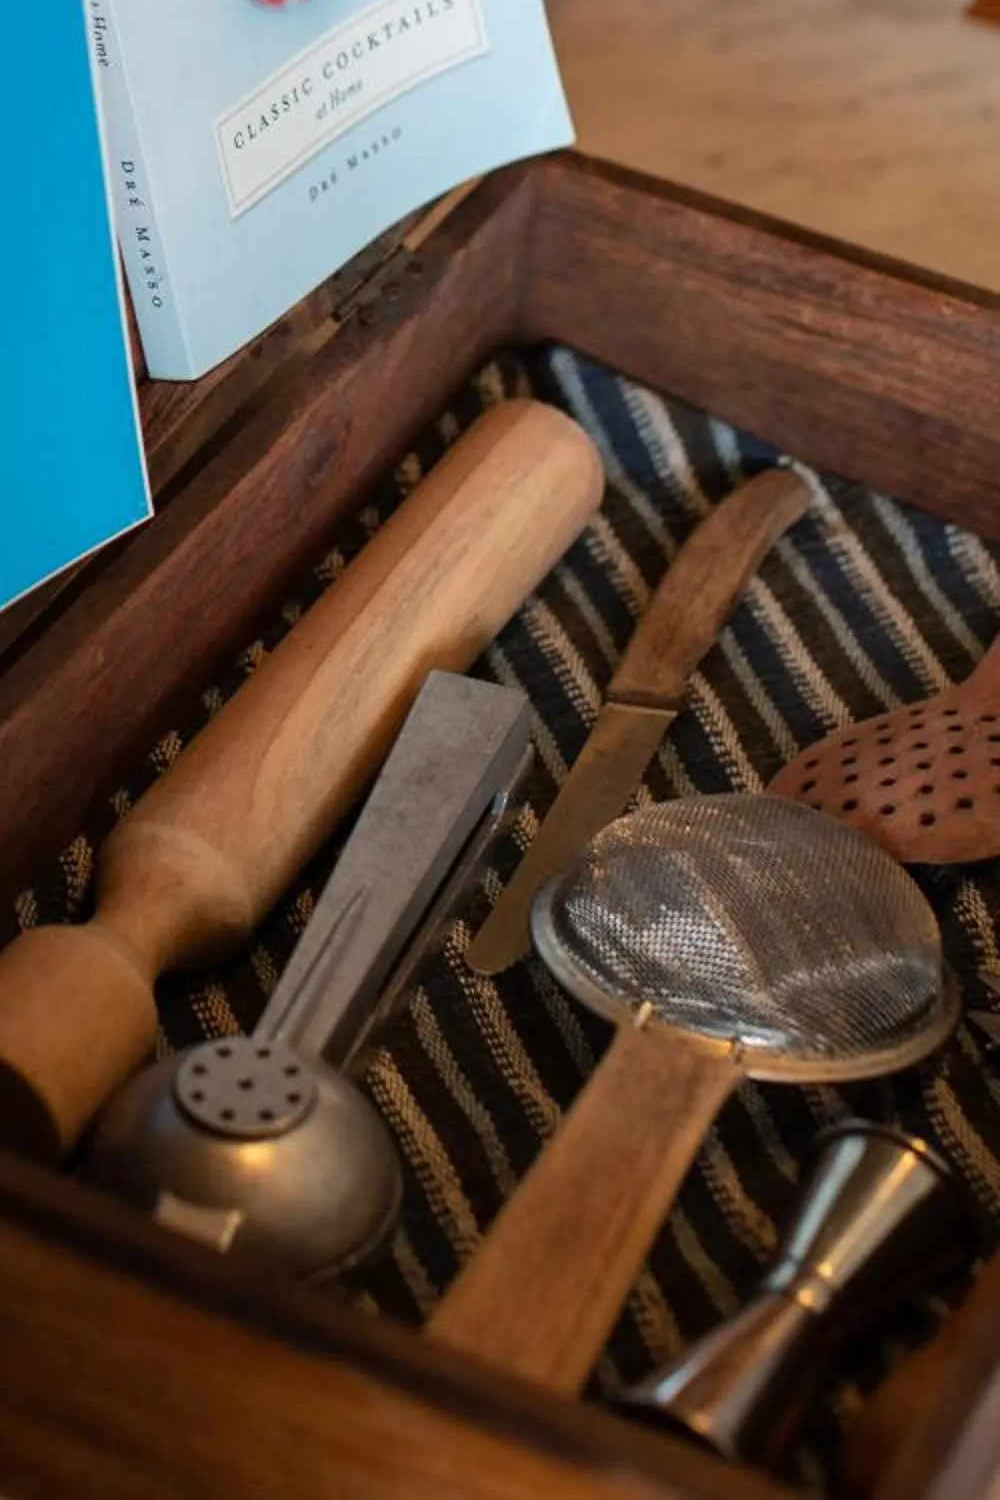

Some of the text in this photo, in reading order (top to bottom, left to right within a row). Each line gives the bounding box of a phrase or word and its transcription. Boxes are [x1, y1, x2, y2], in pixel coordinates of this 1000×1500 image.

[233, 77, 314, 150] CLASSIC
[330, 78, 363, 111] Home
[135, 227, 163, 309] MASSO
